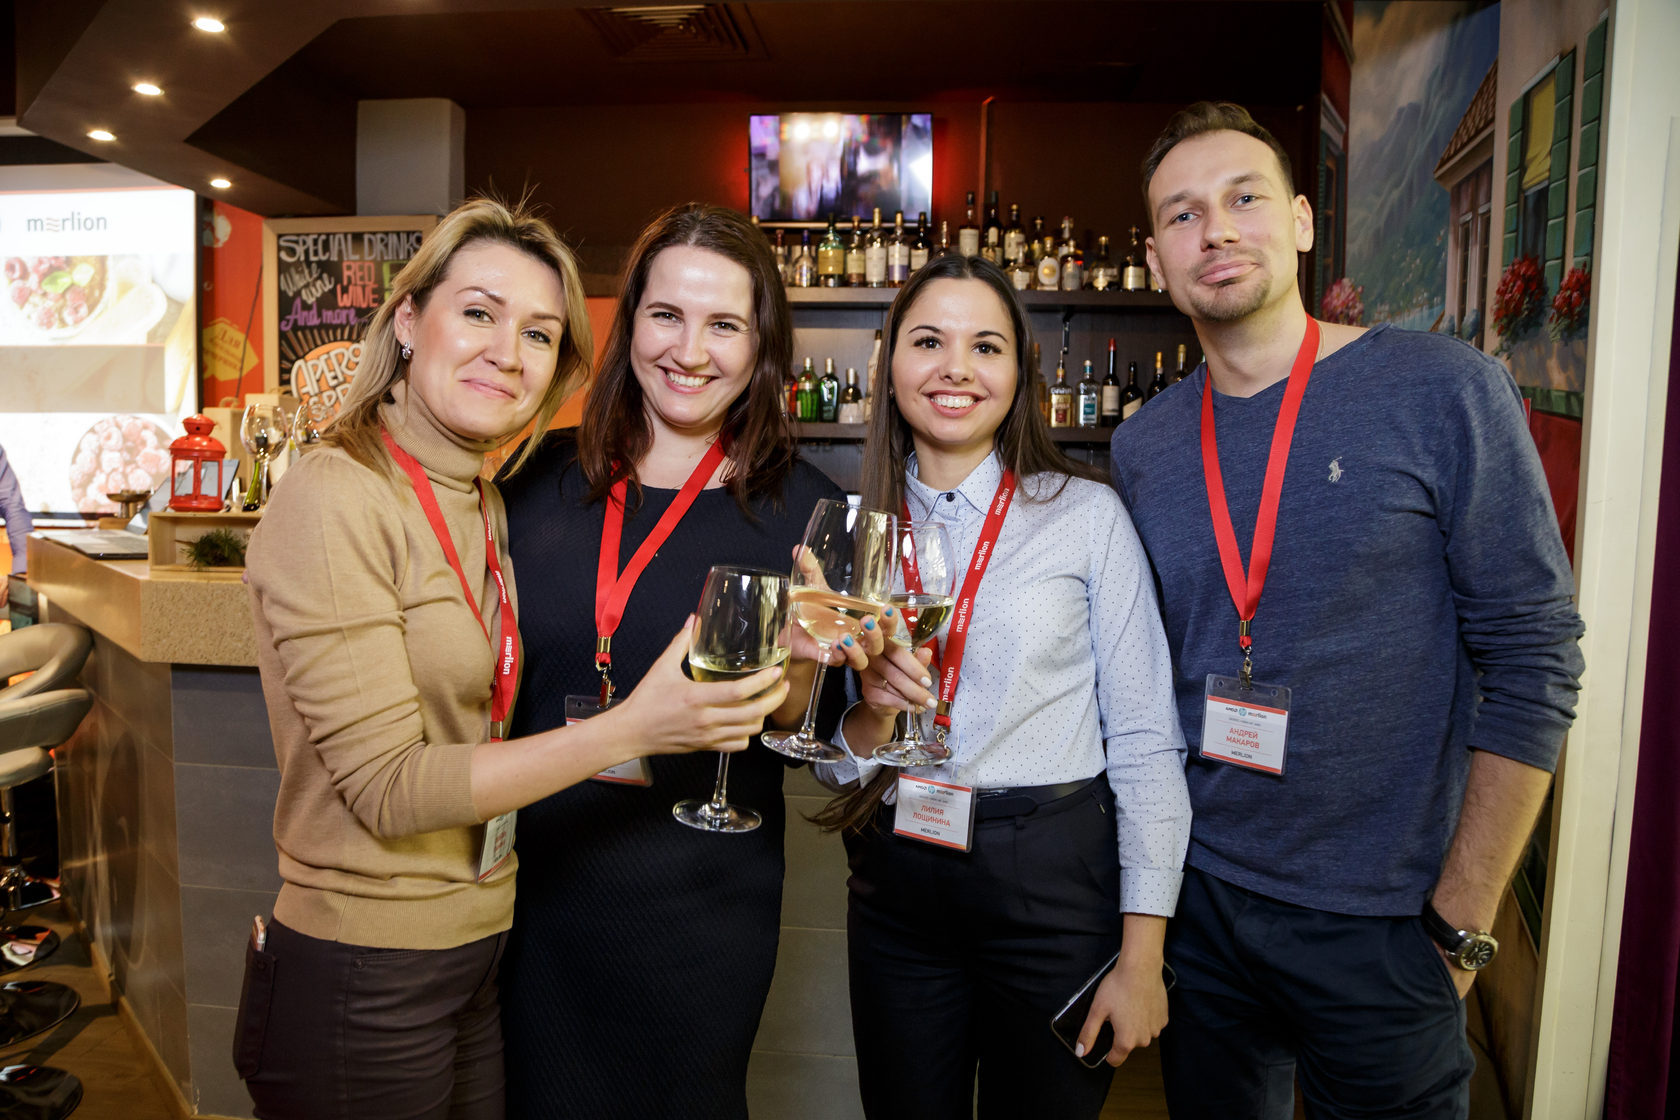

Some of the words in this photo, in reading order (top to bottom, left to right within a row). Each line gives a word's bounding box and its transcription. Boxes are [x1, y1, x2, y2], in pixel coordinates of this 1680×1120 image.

[27, 211, 107, 232] merlion
[279, 234, 359, 261] SPECIAL
[342, 261, 375, 286] RED
[336, 283, 379, 308] WINE
[280, 296, 320, 331] And
[994, 487, 1010, 516] merlion
[974, 541, 990, 571] merlion
[956, 598, 970, 633] merlion
[502, 635, 515, 675] merlion
[1226, 736, 1259, 749] МАКАРОВ
[1229, 727, 1258, 739] АНДРЕЙ
[913, 811, 950, 827] ЛОЩИНИНА
[921, 804, 944, 816] ЛИЛИЯ
